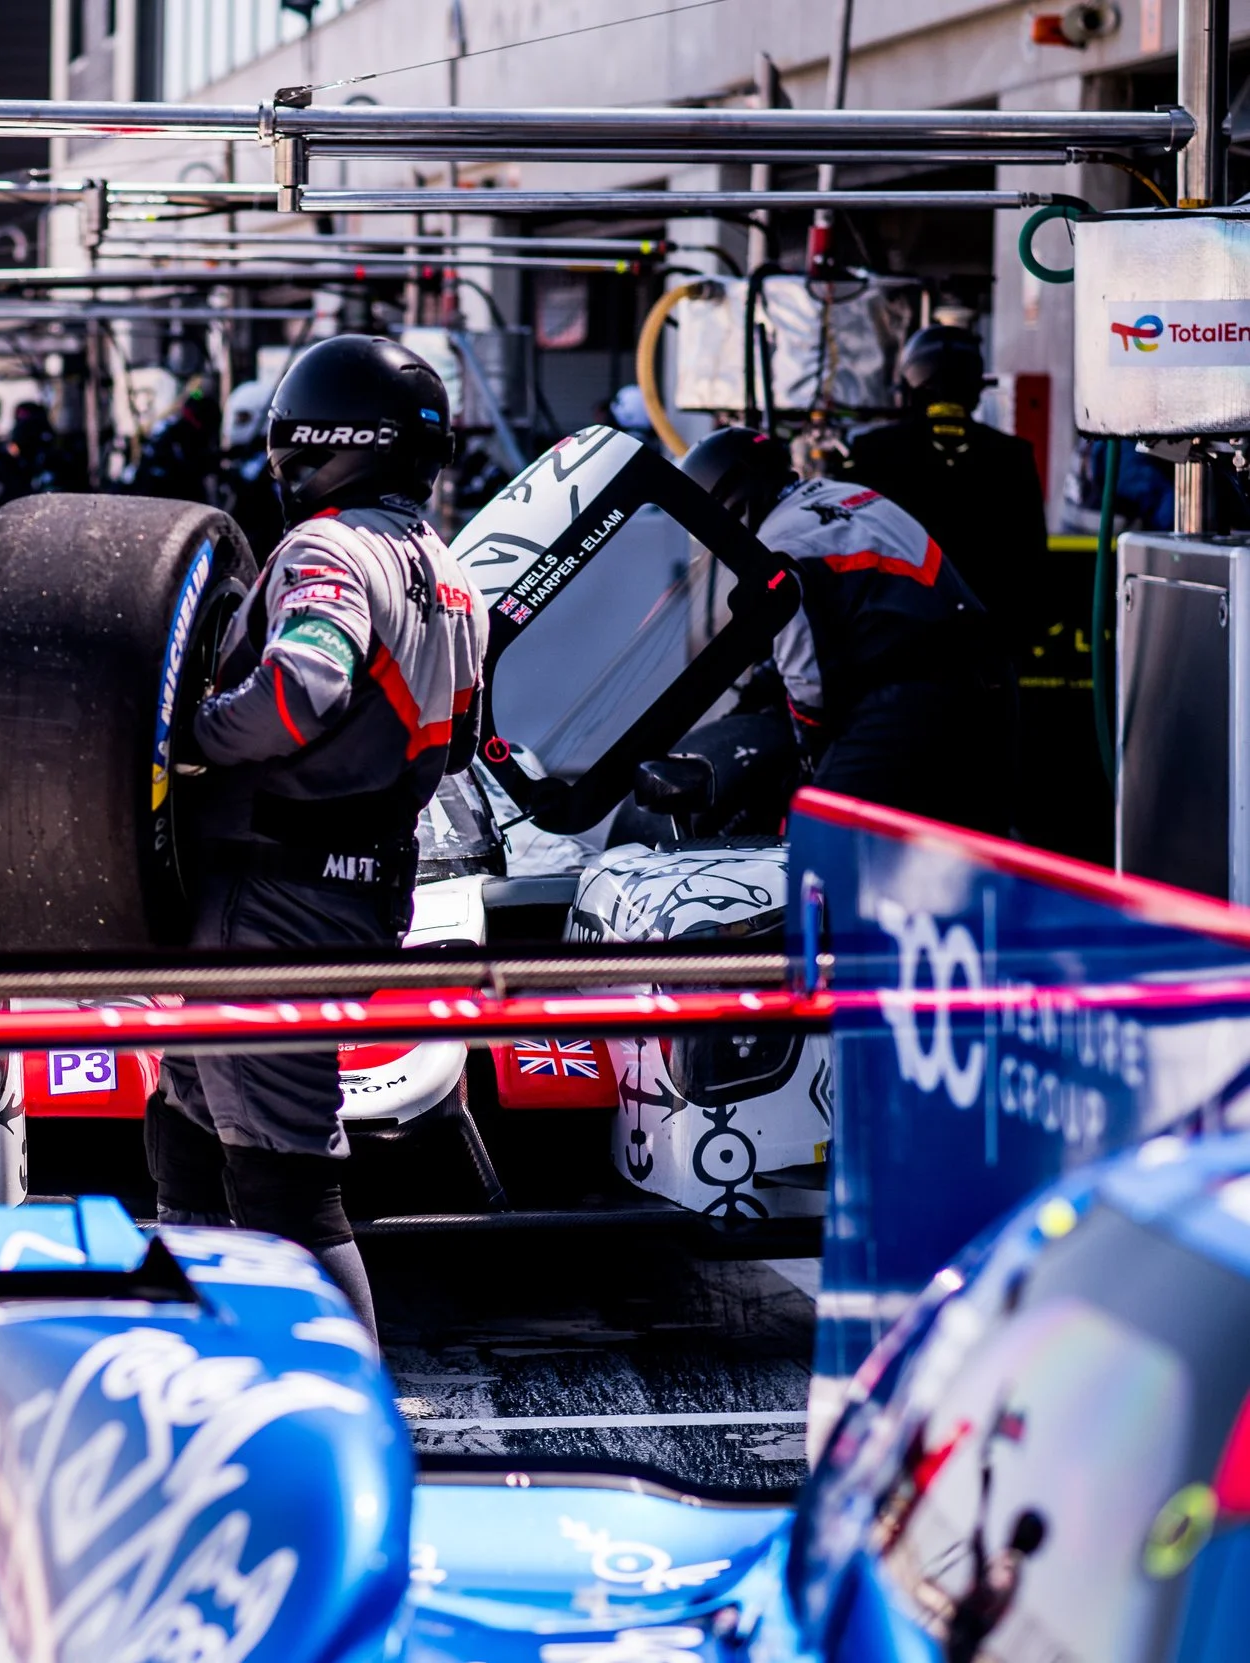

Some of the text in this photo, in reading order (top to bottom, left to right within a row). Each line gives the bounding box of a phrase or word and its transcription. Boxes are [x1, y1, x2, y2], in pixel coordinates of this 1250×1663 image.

[513, 554, 558, 597] WELLS
[527, 555, 580, 607] HARPER
[580, 508, 625, 552] ELLAM
[161, 554, 209, 726] MICHELIN
[53, 1052, 112, 1086] P3
